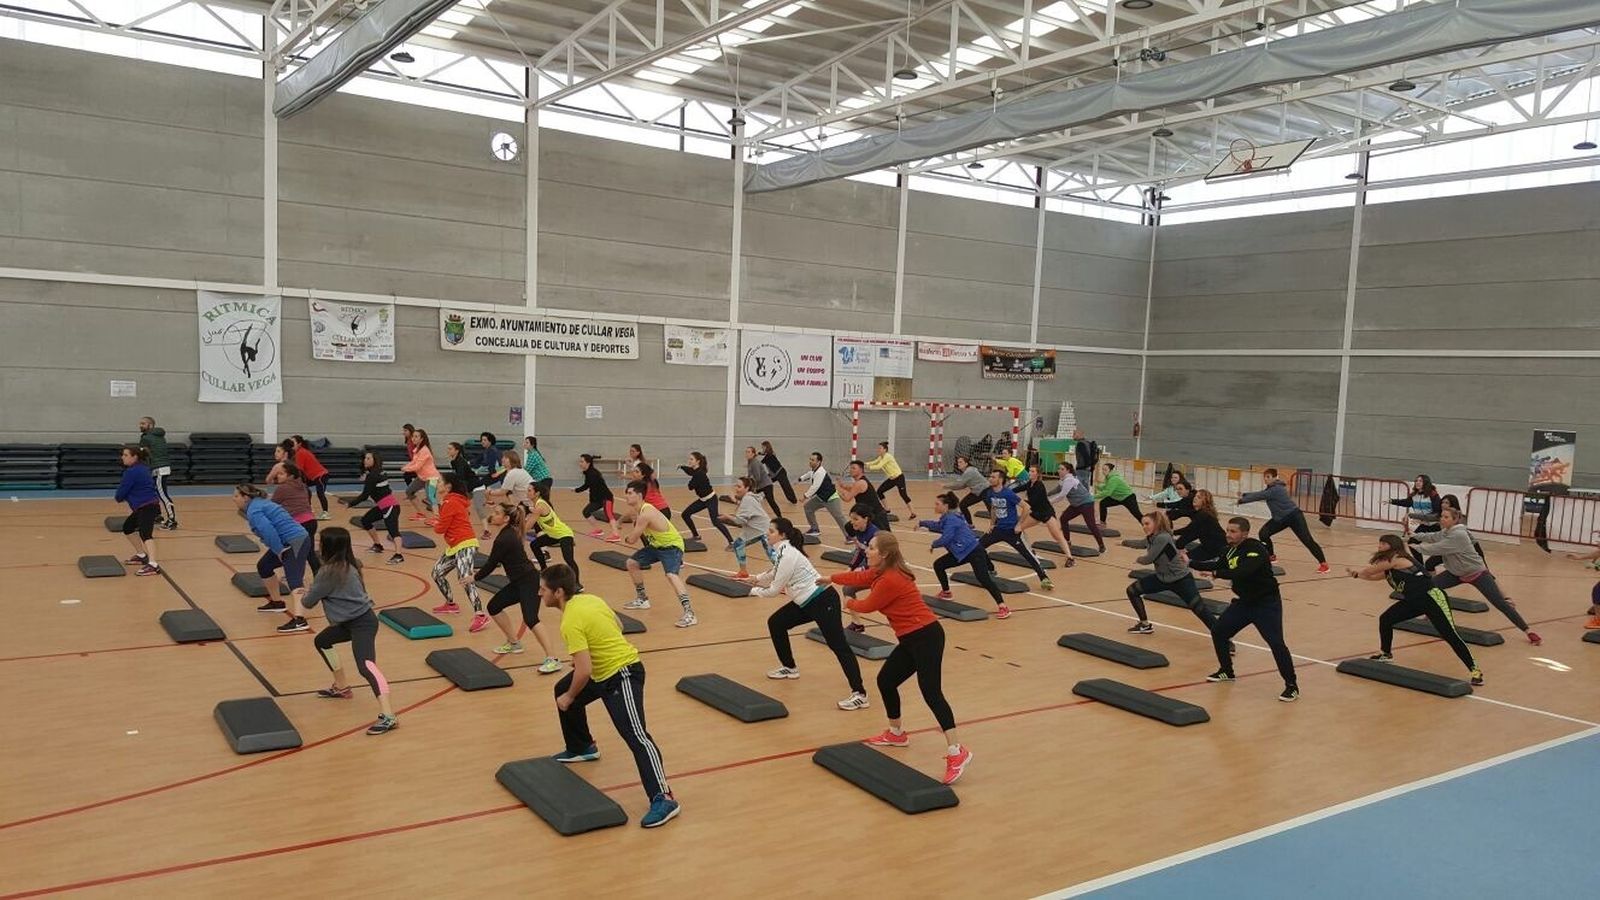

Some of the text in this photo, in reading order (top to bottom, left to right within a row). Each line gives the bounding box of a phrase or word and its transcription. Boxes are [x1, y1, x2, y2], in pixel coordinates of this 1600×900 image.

[203, 302, 277, 326] RITMICA
[470, 316, 635, 338] EXMO. AYUNTAMIENTO DE CULLAR VEGA
[530, 339, 542, 349] DE
[544, 340, 581, 352] CULTURA
[583, 342, 588, 352] Y
[591, 342, 630, 354] DEPORTES
[201, 370, 276, 393] CULLAR VEGA
